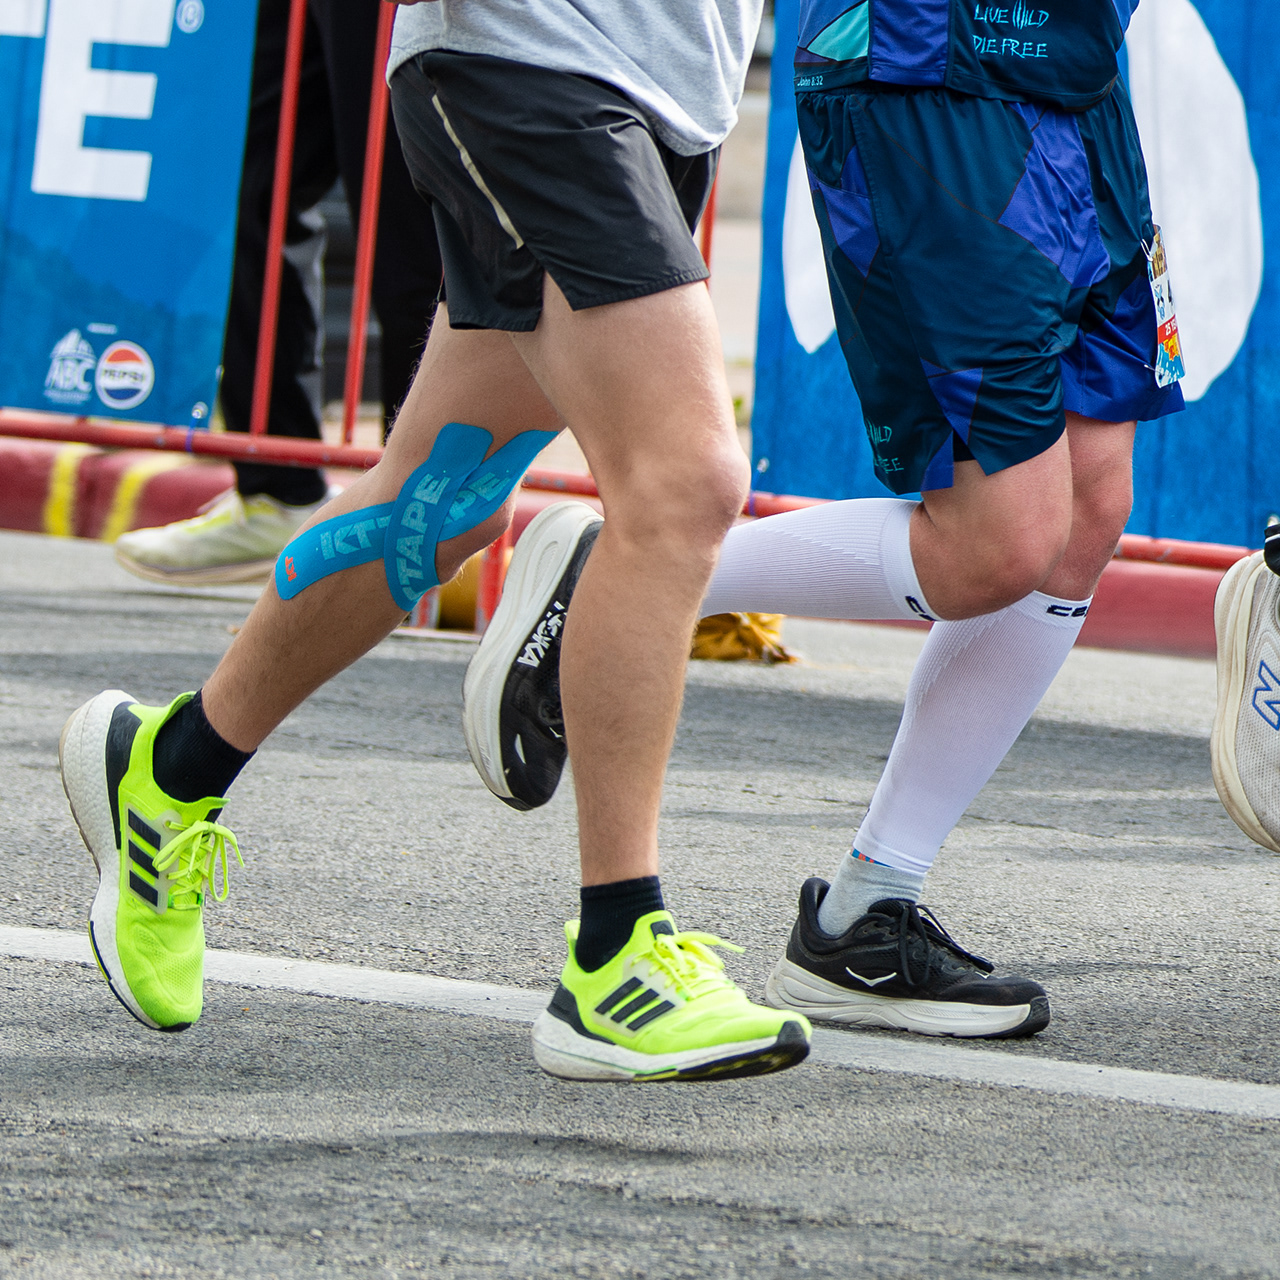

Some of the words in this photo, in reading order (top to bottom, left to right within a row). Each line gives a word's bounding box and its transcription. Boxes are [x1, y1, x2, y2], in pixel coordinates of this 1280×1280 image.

[974, 3, 1008, 25] LIVE
[45, 357, 94, 393] ABC
[396, 473, 451, 587] TAPE
[1046, 604, 1088, 618] CE
